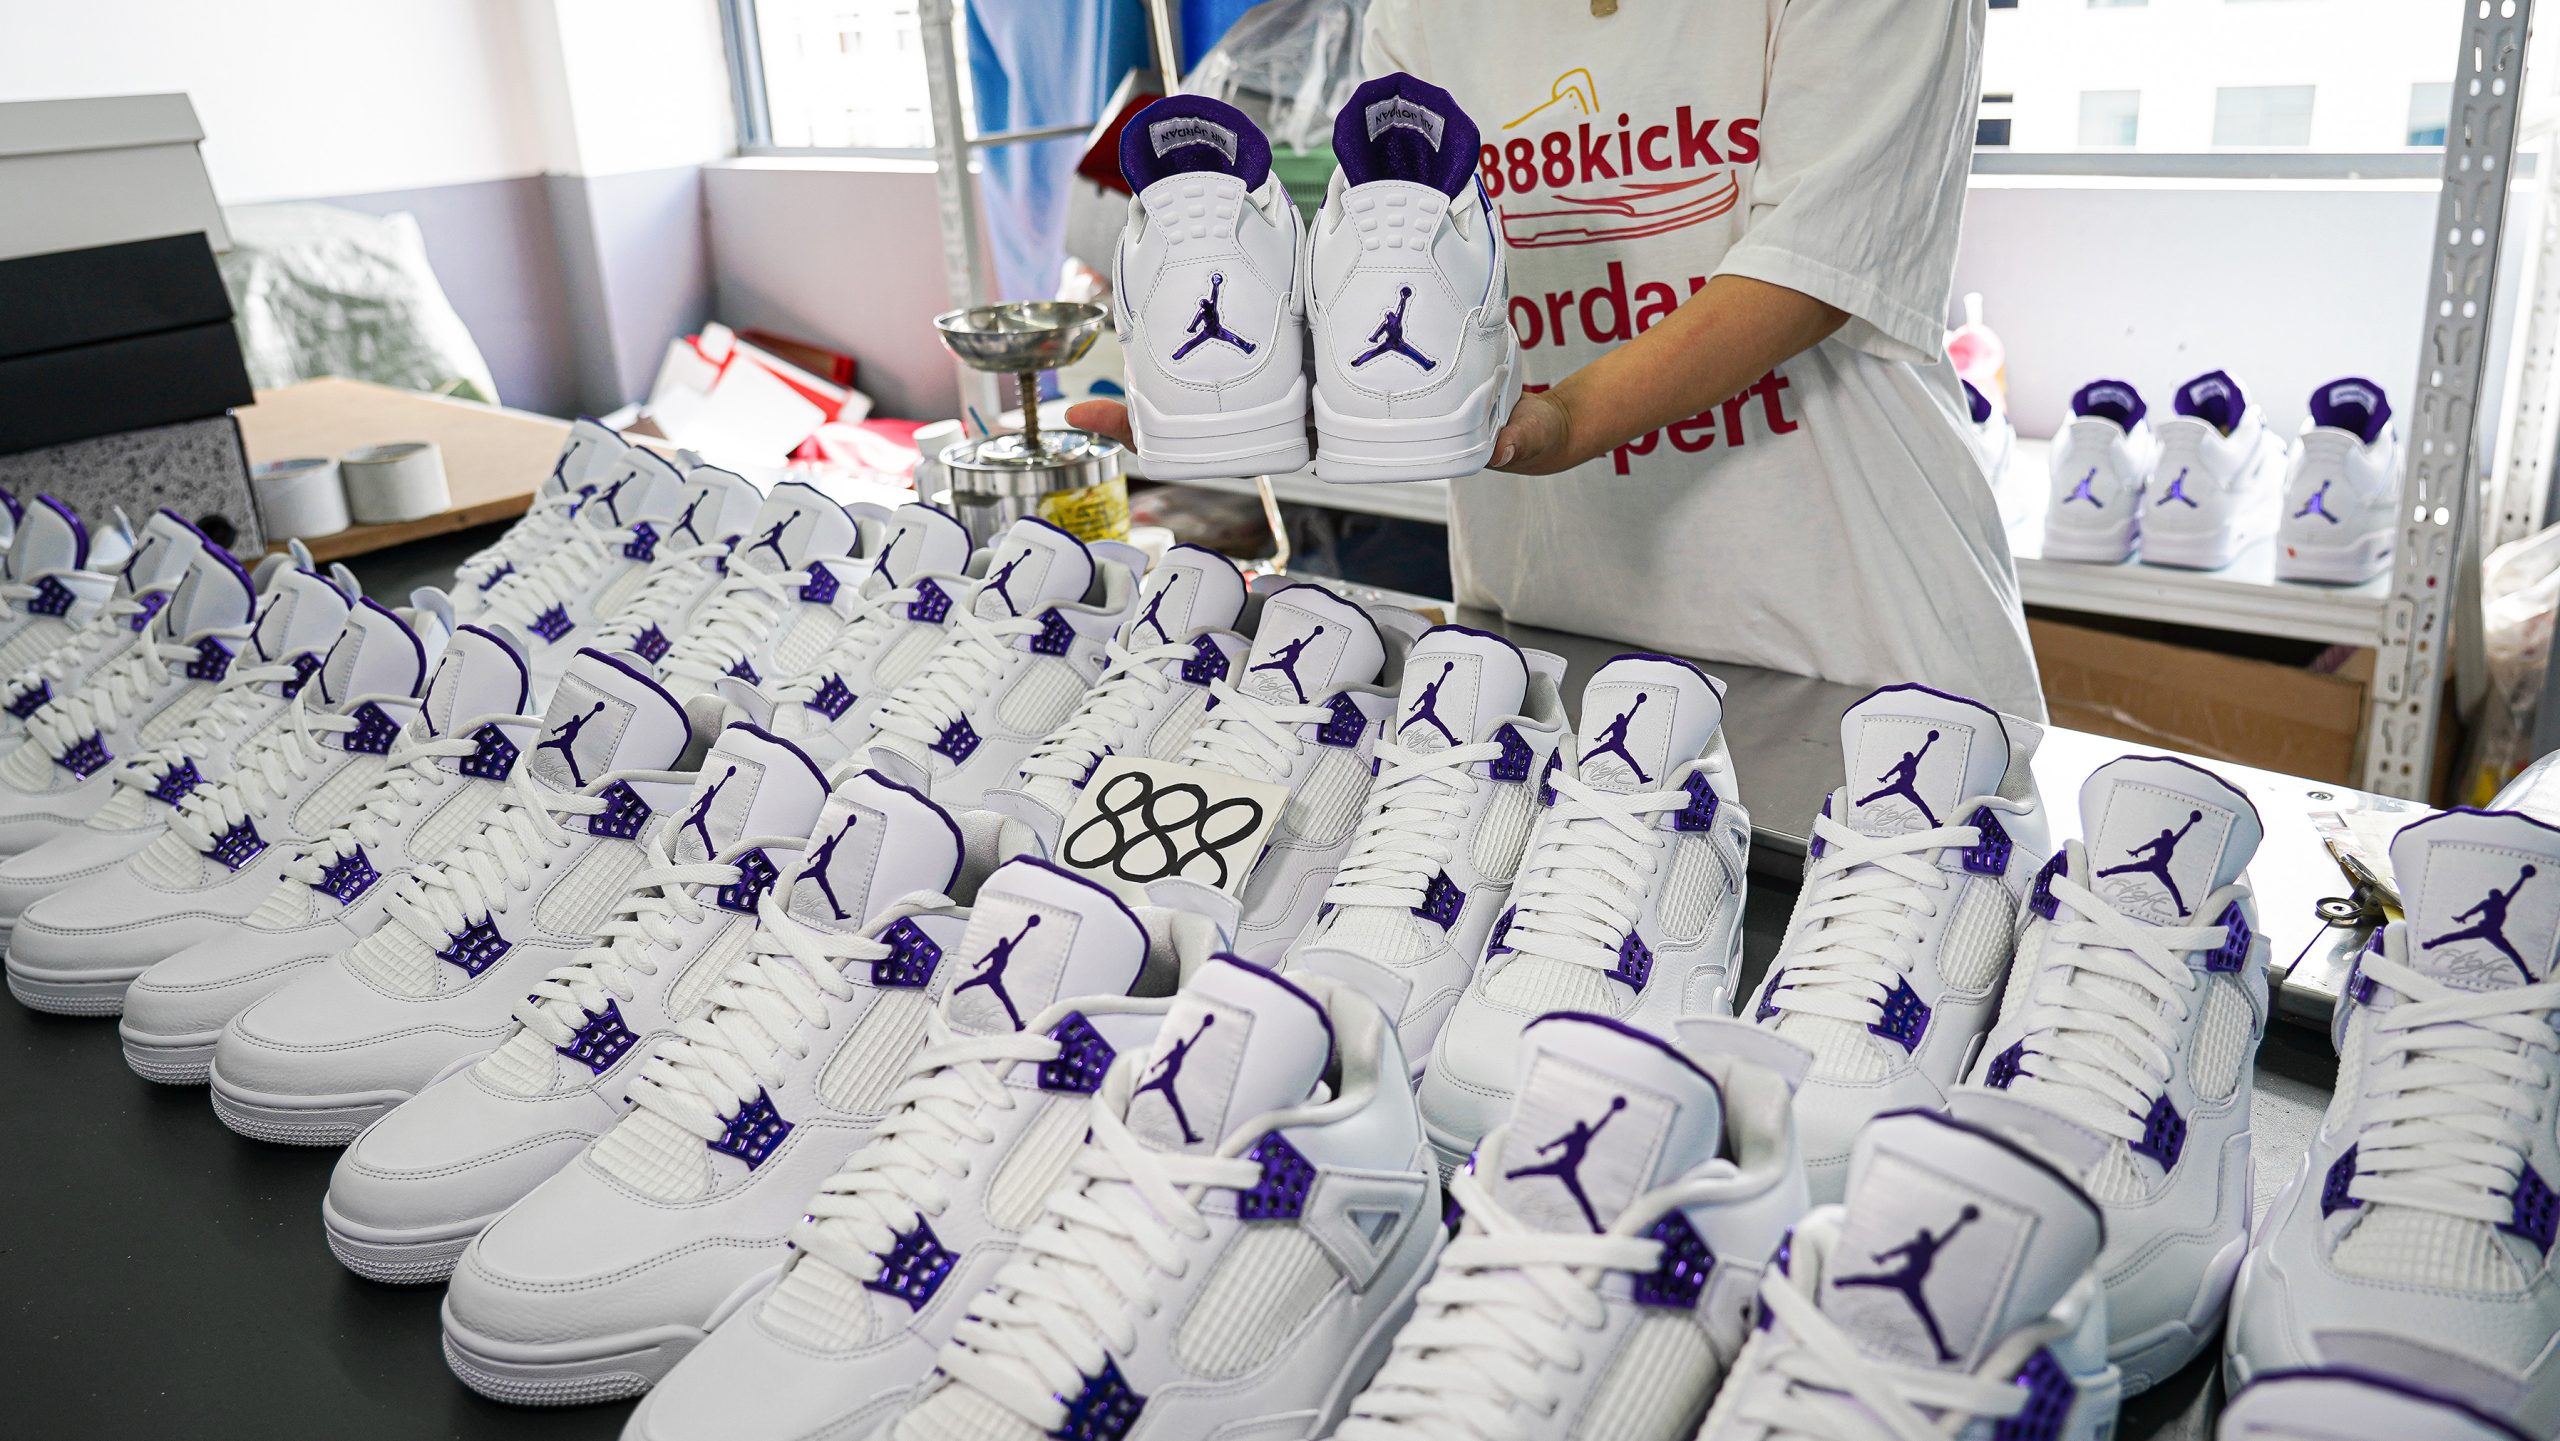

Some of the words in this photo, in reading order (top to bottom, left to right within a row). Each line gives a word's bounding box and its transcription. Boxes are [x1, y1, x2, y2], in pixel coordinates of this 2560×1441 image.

[1160, 125, 1209, 143] JORDAN
[1479, 105, 1760, 198] 888kicks
[1064, 771, 1263, 890] 888
